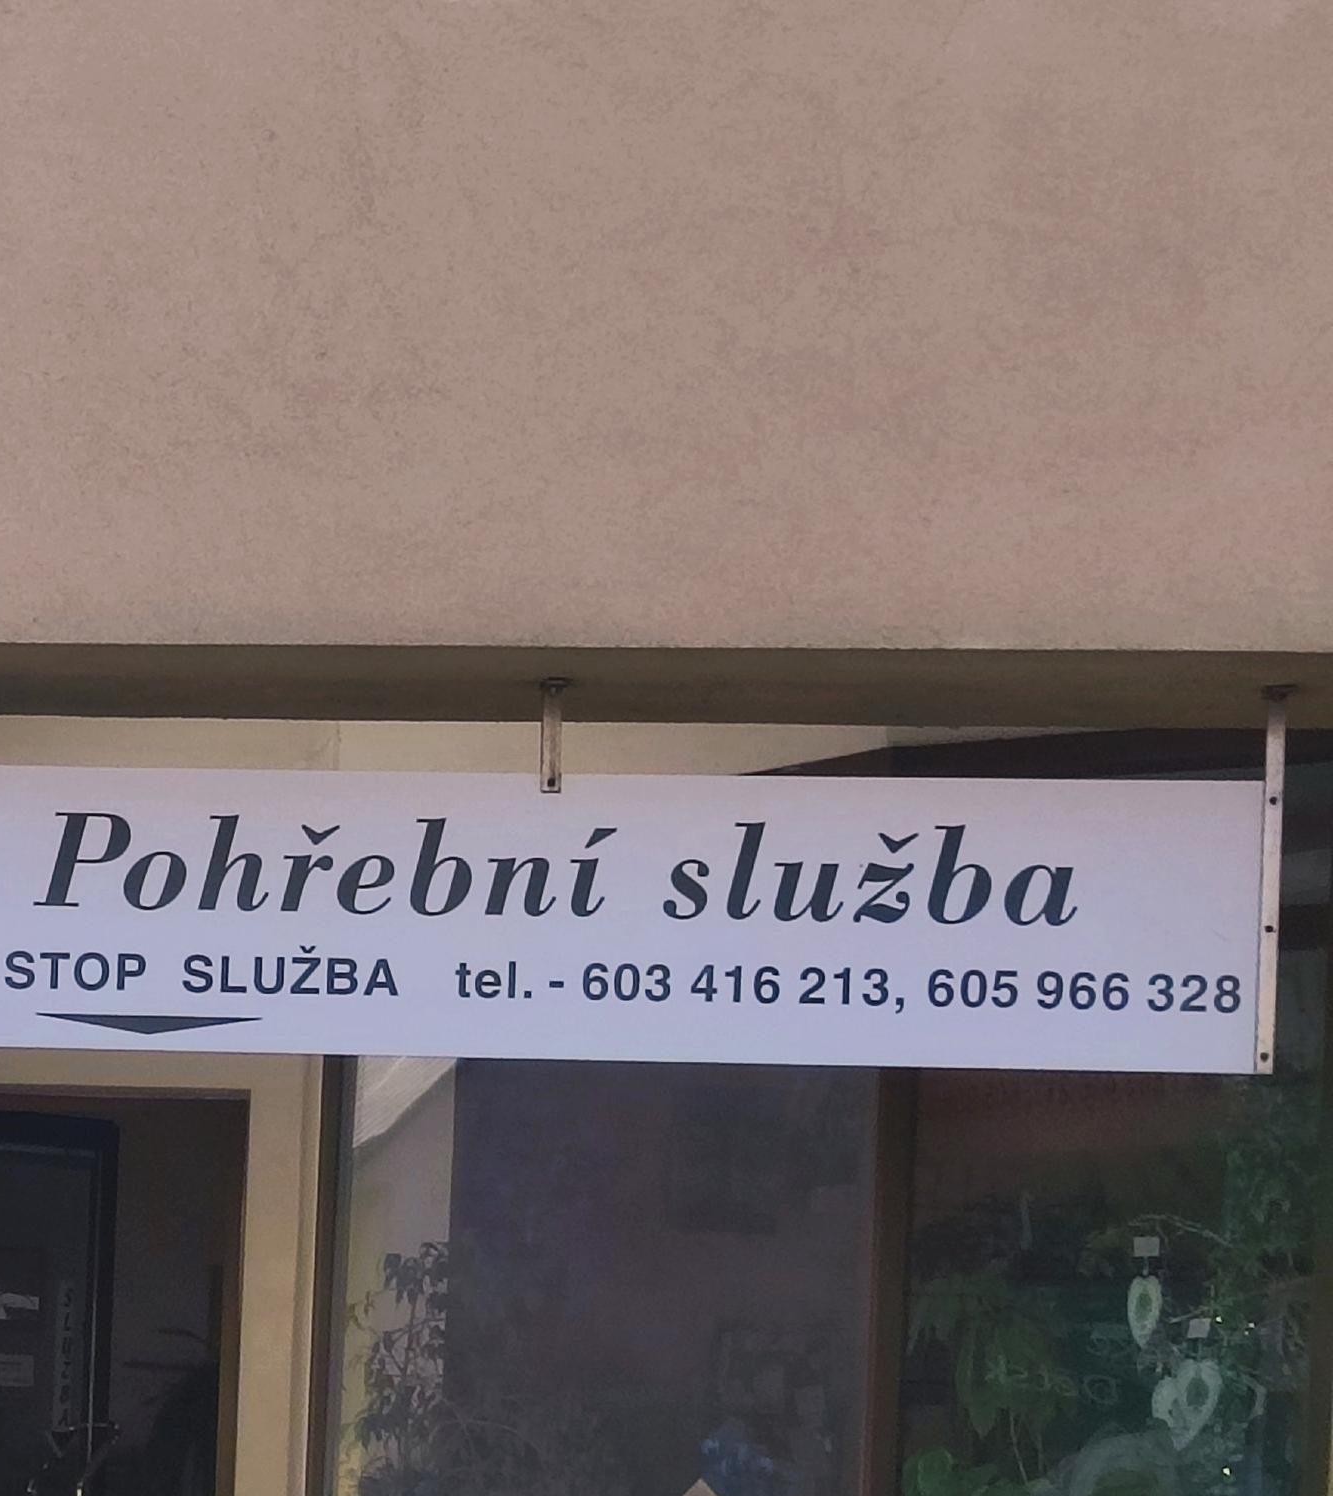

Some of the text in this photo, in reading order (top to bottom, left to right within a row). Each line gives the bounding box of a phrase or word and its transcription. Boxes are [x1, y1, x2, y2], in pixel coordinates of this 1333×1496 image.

[31, 809, 1079, 926] Pohřební služba
[4, 951, 148, 992] STOP
[181, 944, 400, 997] SLUŽBA
[581, 962, 673, 1003] 603
[689, 965, 781, 1005] 416
[798, 967, 905, 1015] 213,
[926, 968, 1020, 1009] 605
[1035, 970, 1130, 1012] 966
[1145, 973, 1242, 1015] 328
